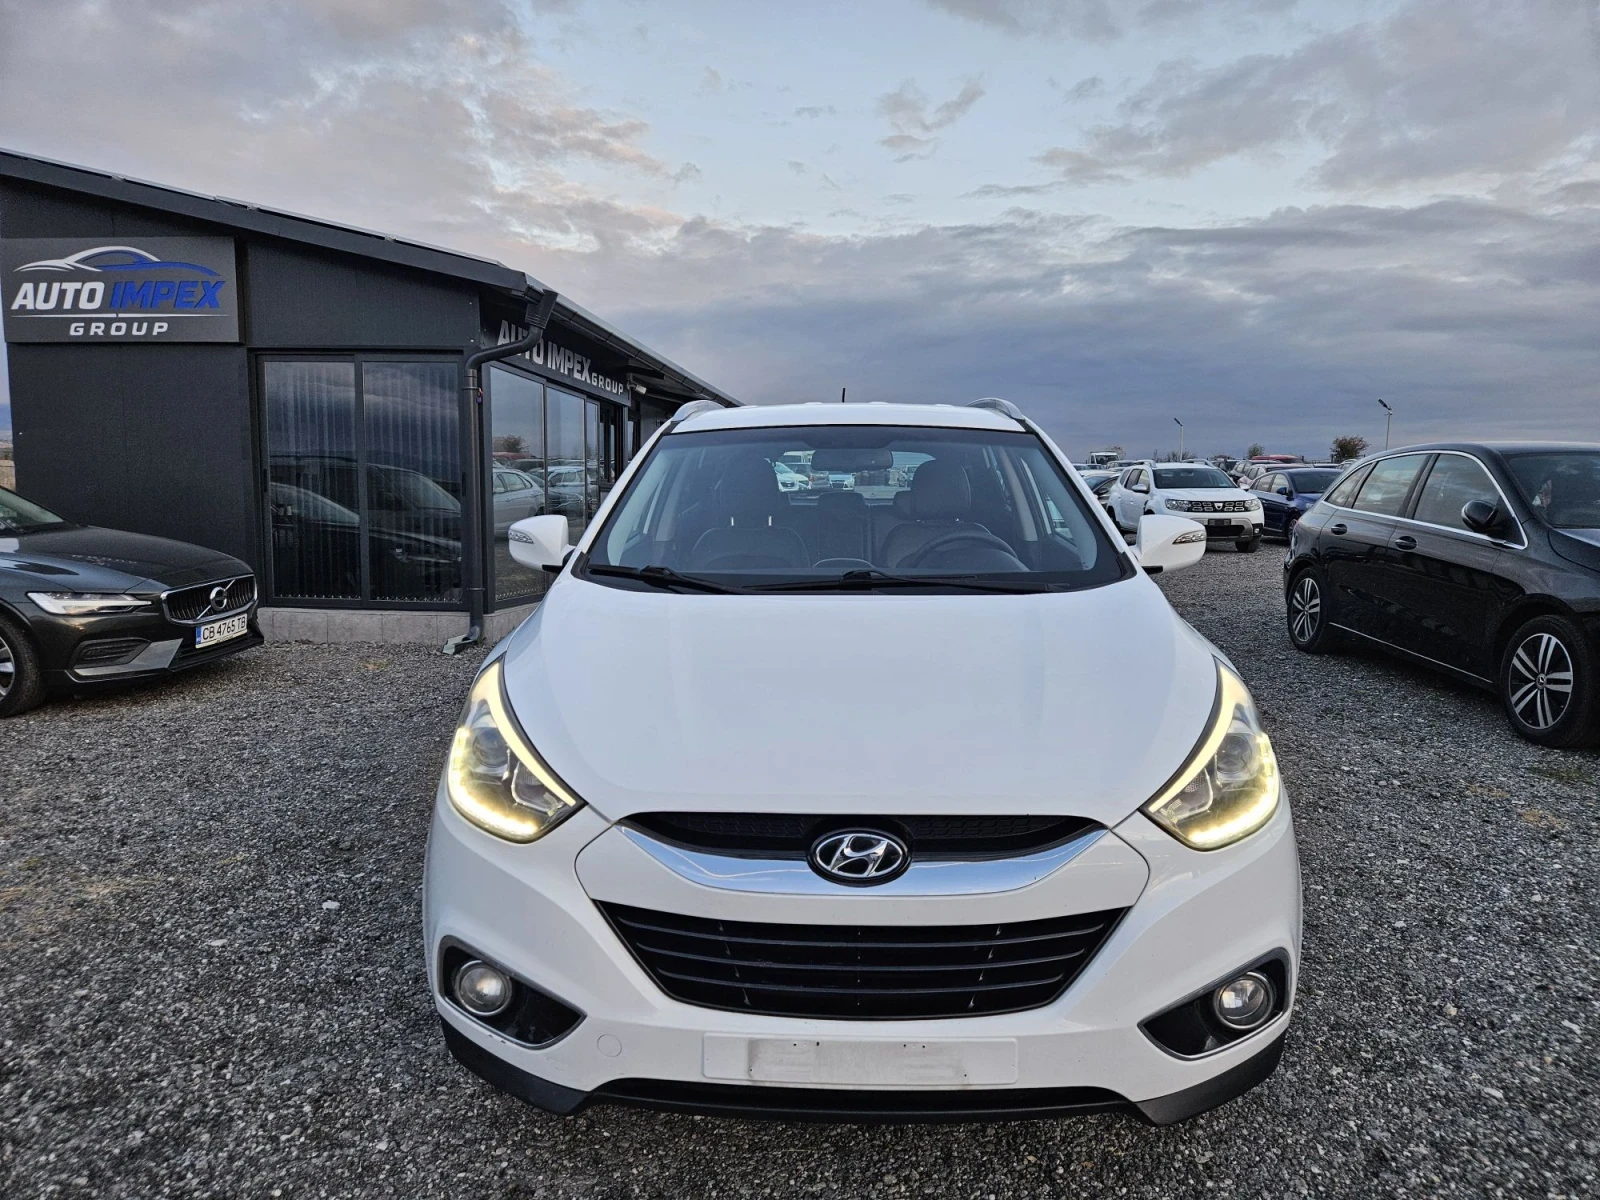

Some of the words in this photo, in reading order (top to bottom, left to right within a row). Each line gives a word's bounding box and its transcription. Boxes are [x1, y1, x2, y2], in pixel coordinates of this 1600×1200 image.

[11, 281, 105, 310] AUTO
[109, 280, 226, 310] IMPEX
[69, 322, 168, 336] GROUP
[547, 341, 591, 383] IMPEX
[591, 374, 624, 395] GROUP
[202, 626, 215, 640] CB
[217, 620, 235, 635] 4765
[237, 616, 246, 630] TB
